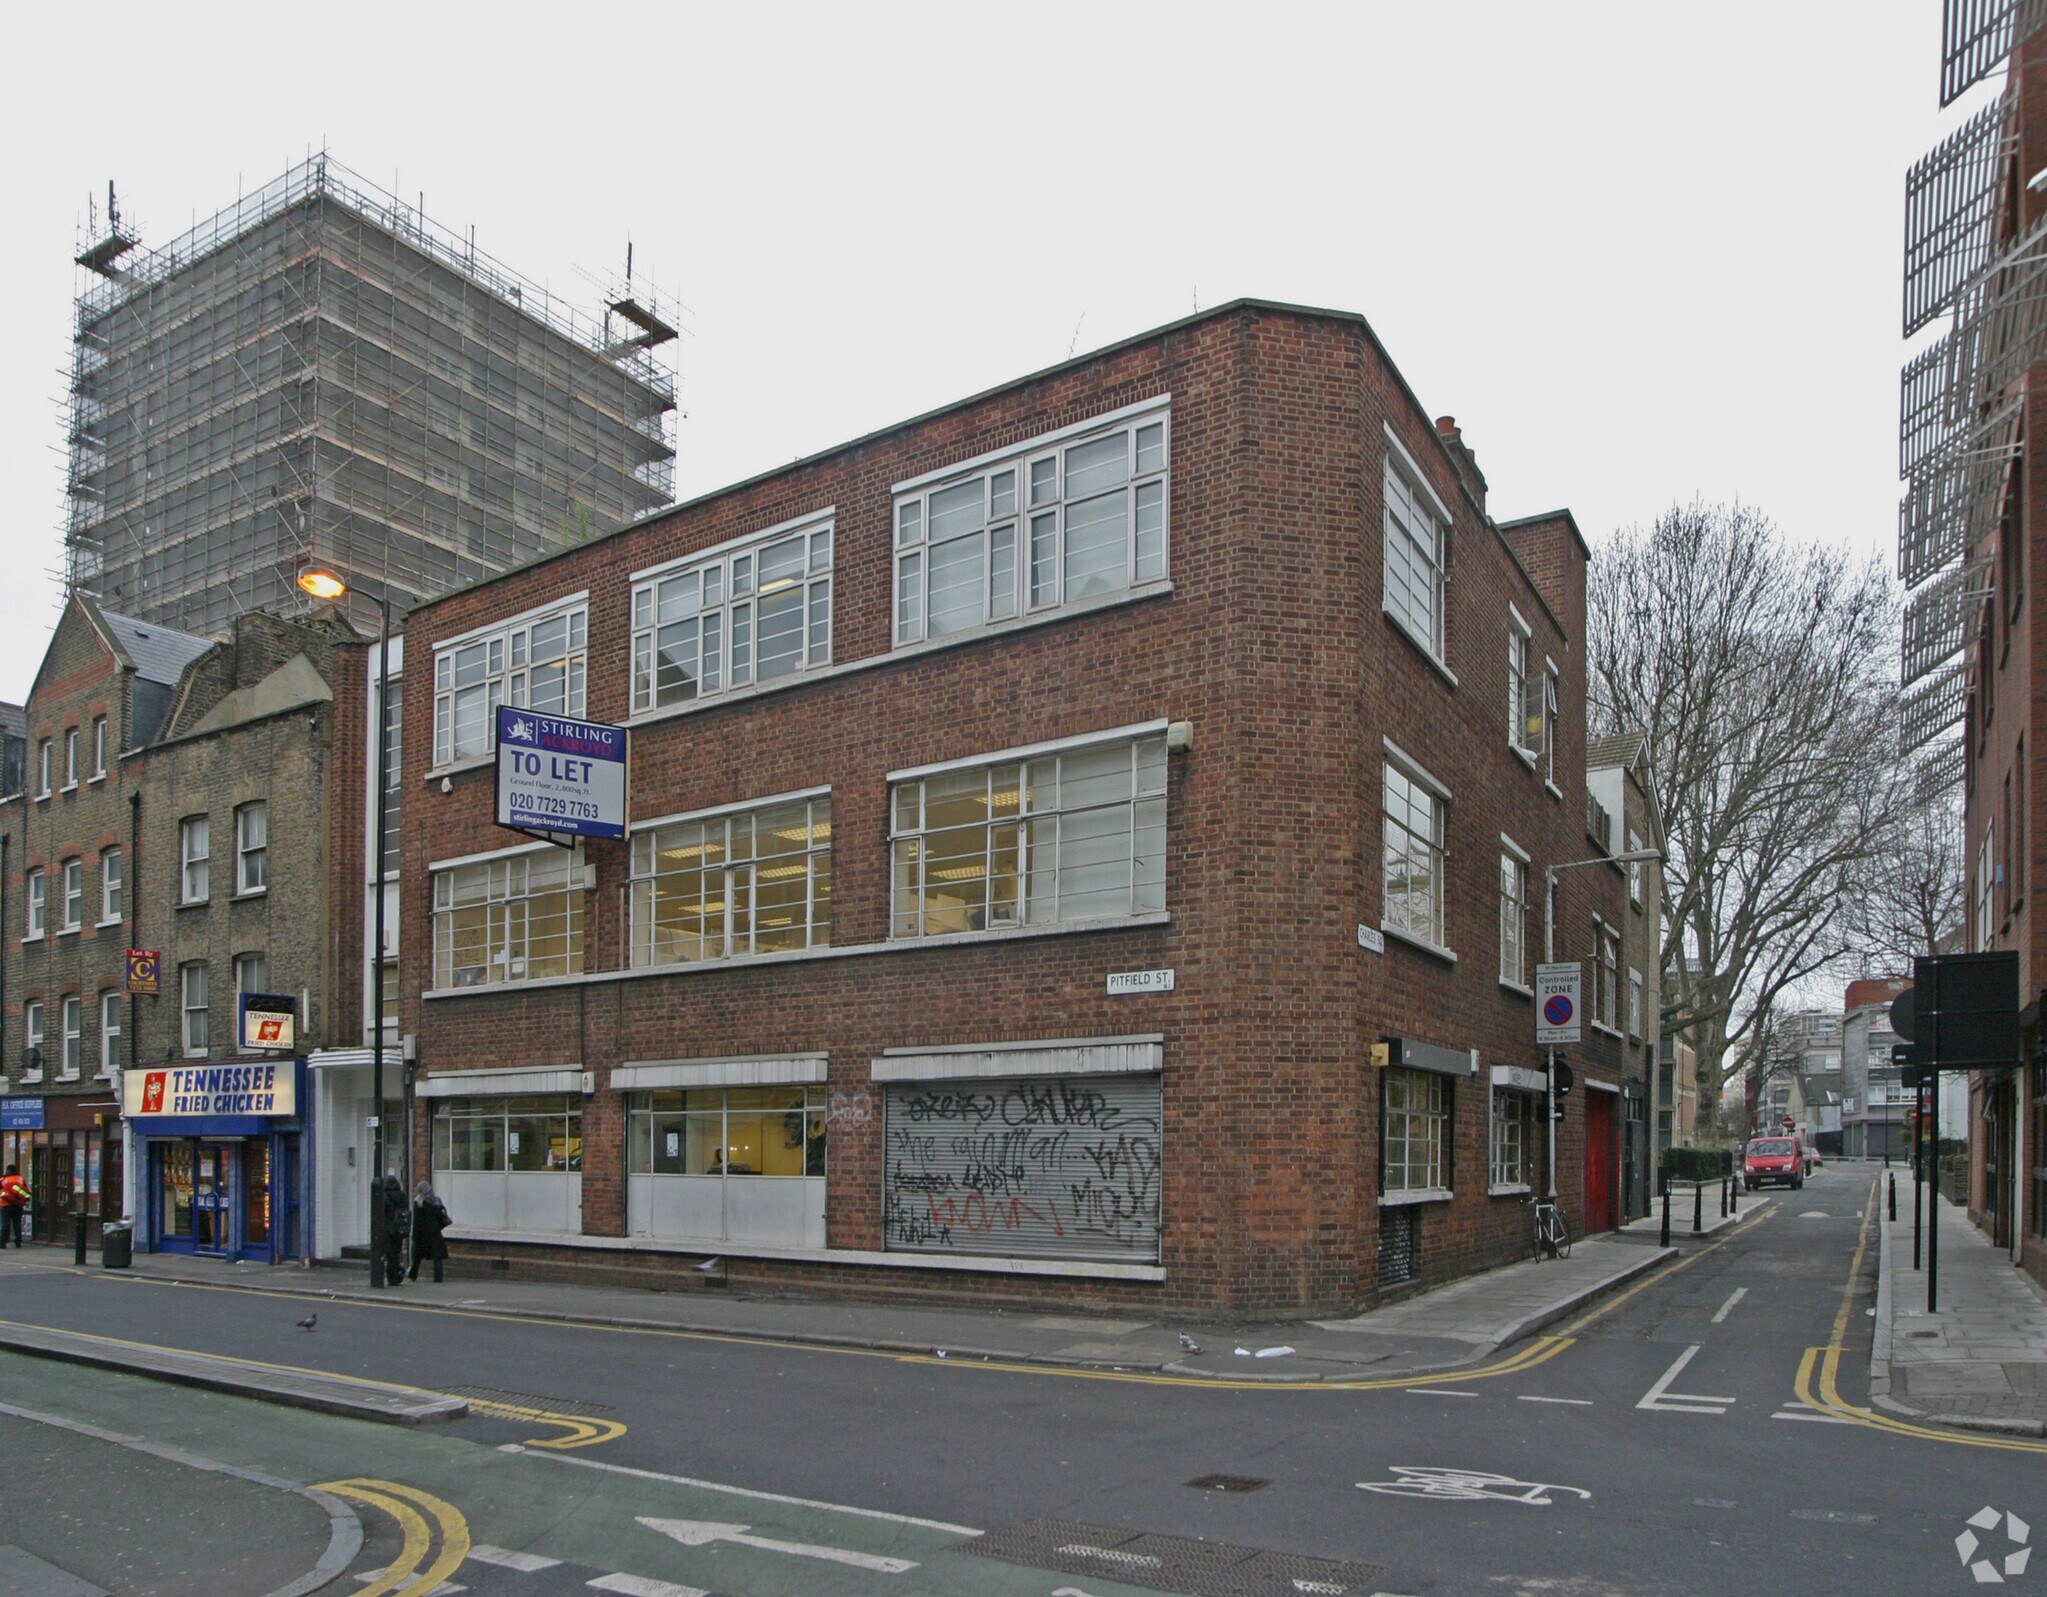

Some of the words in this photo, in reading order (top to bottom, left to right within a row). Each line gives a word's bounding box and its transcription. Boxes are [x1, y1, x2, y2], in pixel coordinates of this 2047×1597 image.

[541, 720, 612, 744] STIRLING
[541, 734, 613, 756] ACKROYD
[511, 750, 541, 776] TO
[551, 757, 593, 784] LET
[510, 777, 534, 787] Ground
[510, 792, 533, 810] 020
[537, 796, 566, 814] 7729
[569, 801, 598, 819] 7763
[513, 813, 578, 829] stirlingackroyd.com
[1111, 973, 1151, 987] PITFIELD
[1539, 975, 1579, 984] Controlled
[1544, 985, 1573, 994] ZONE
[249, 1012, 290, 1021] TENNESSEE
[173, 1066, 276, 1093] TENNESSEE
[174, 1095, 210, 1113] FRIED
[214, 1093, 275, 1113] CHICKEN
